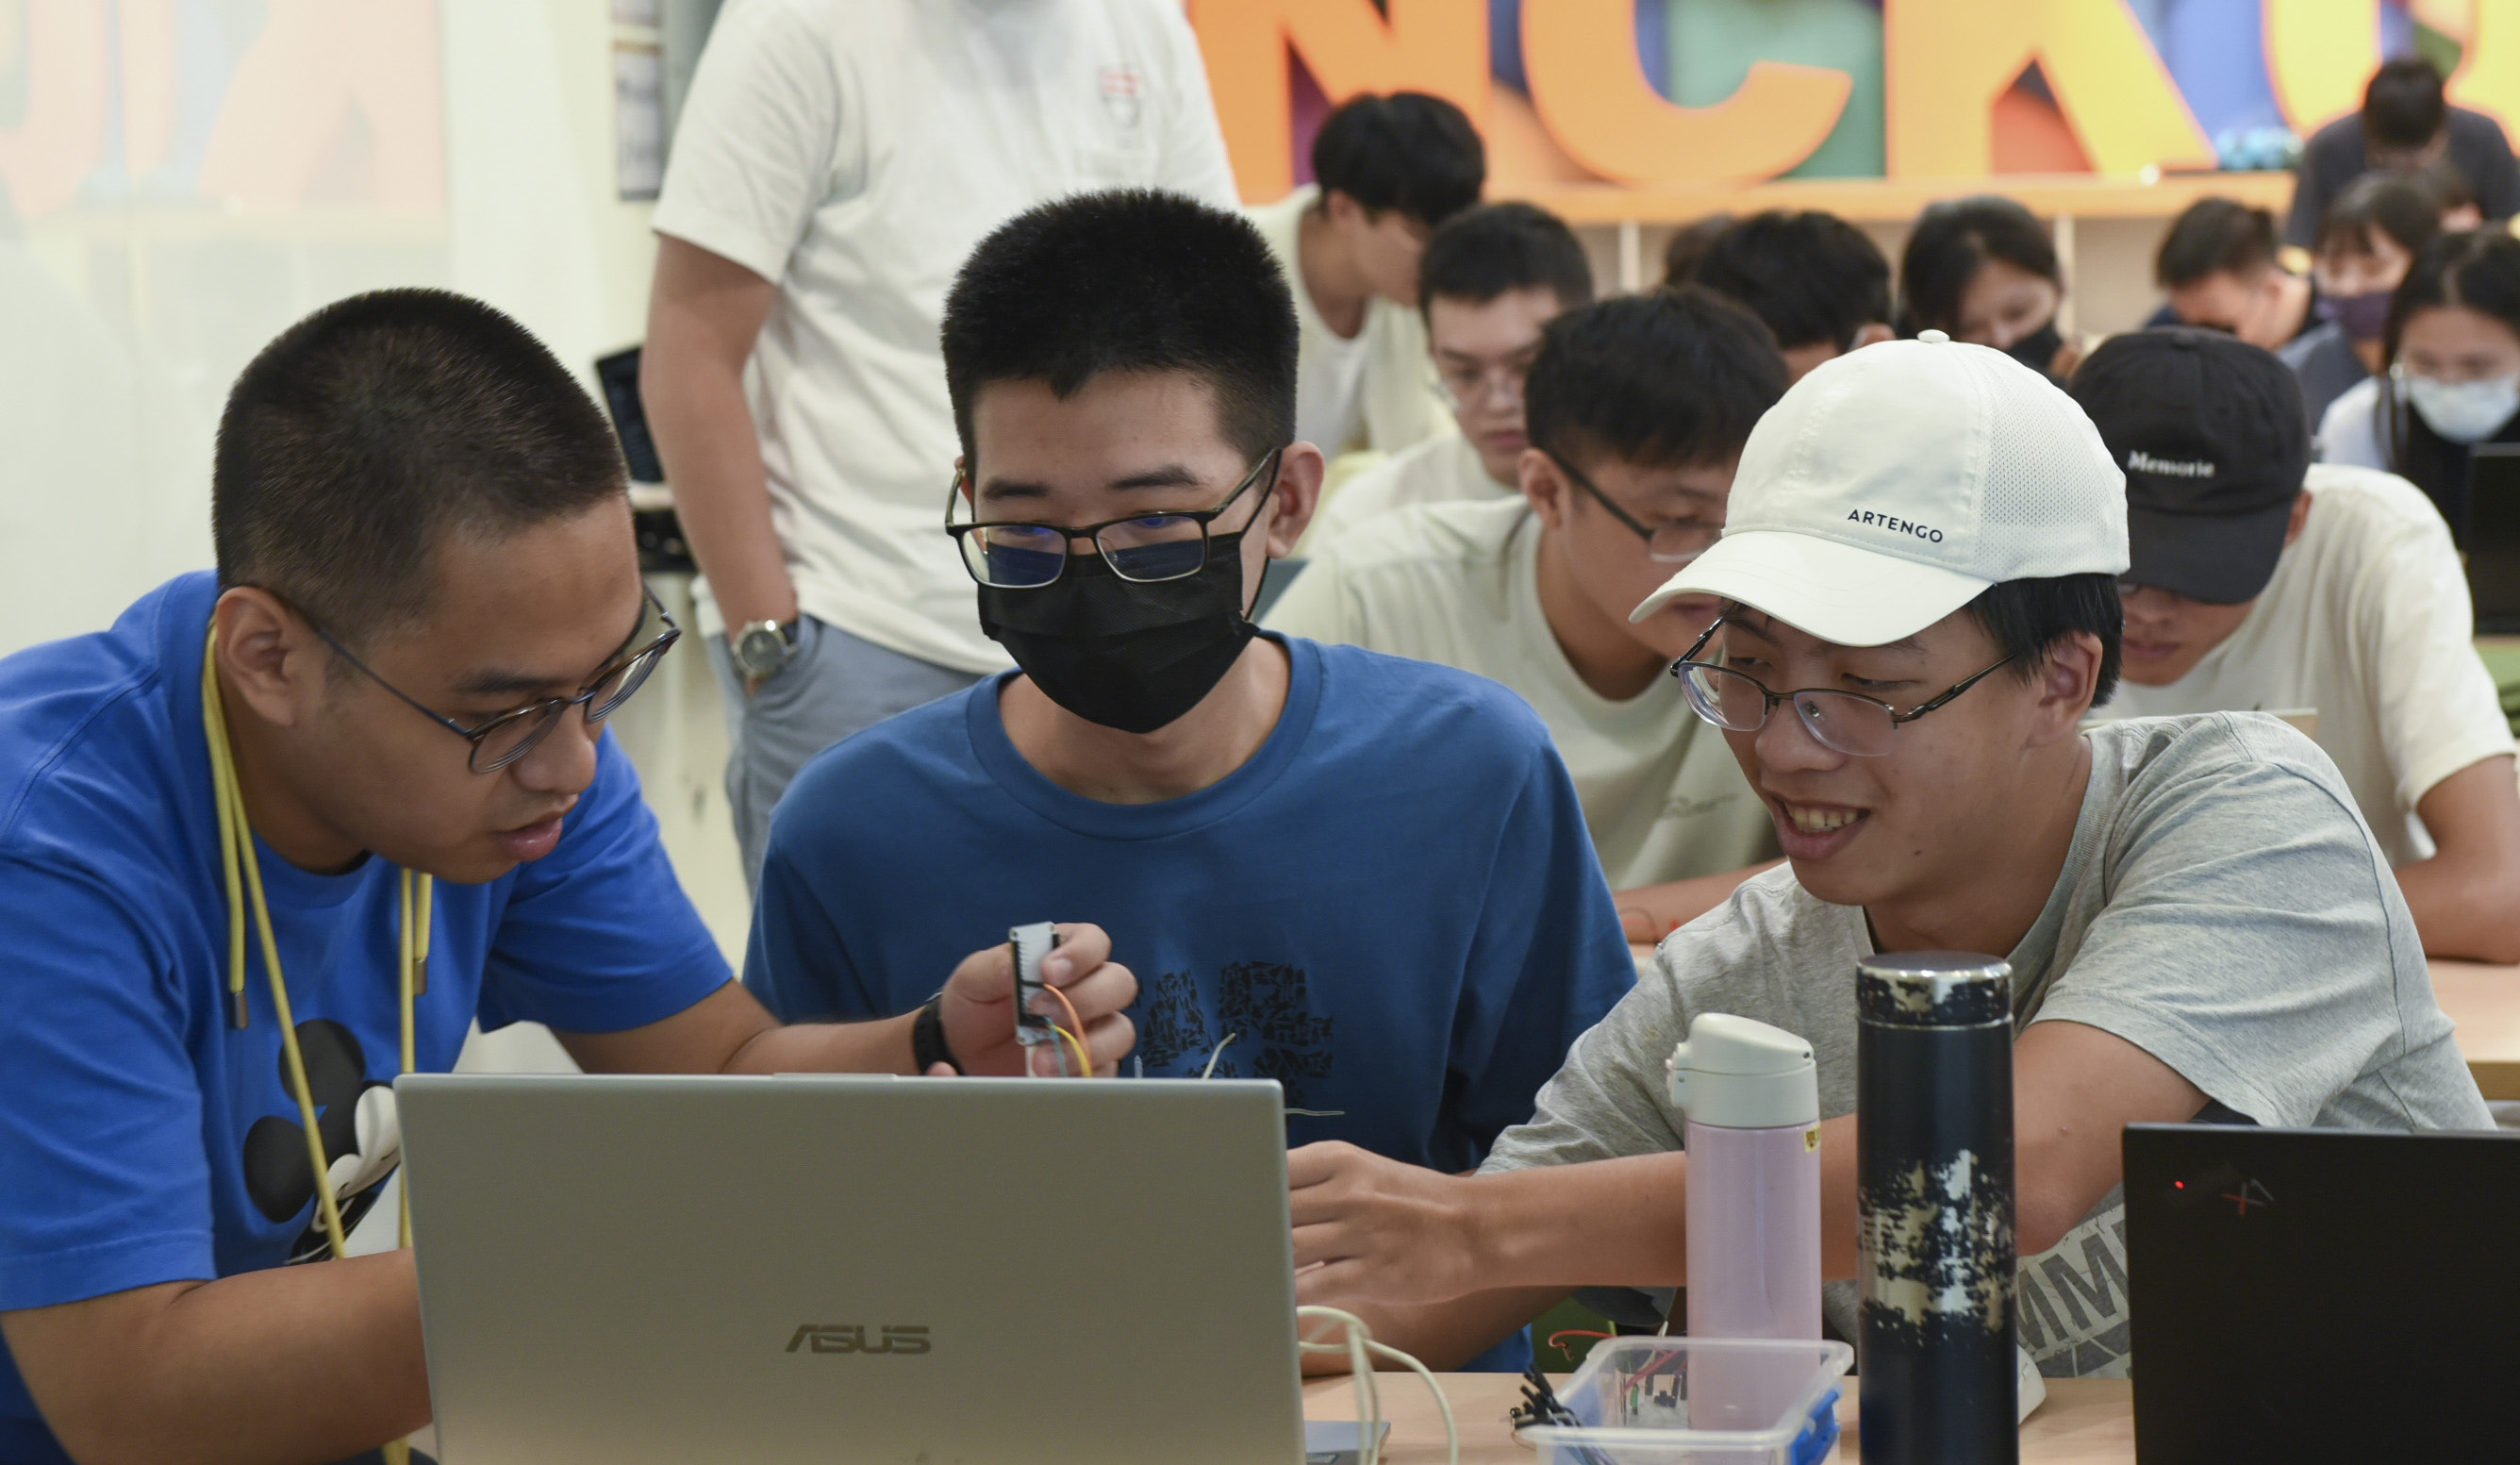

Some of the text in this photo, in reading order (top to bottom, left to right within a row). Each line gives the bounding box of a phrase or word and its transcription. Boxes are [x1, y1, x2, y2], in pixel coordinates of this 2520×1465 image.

[2127, 449, 2215, 477] Memorie
[1847, 508, 1943, 543] ARTENGO
[785, 1324, 932, 1354] ASUS
